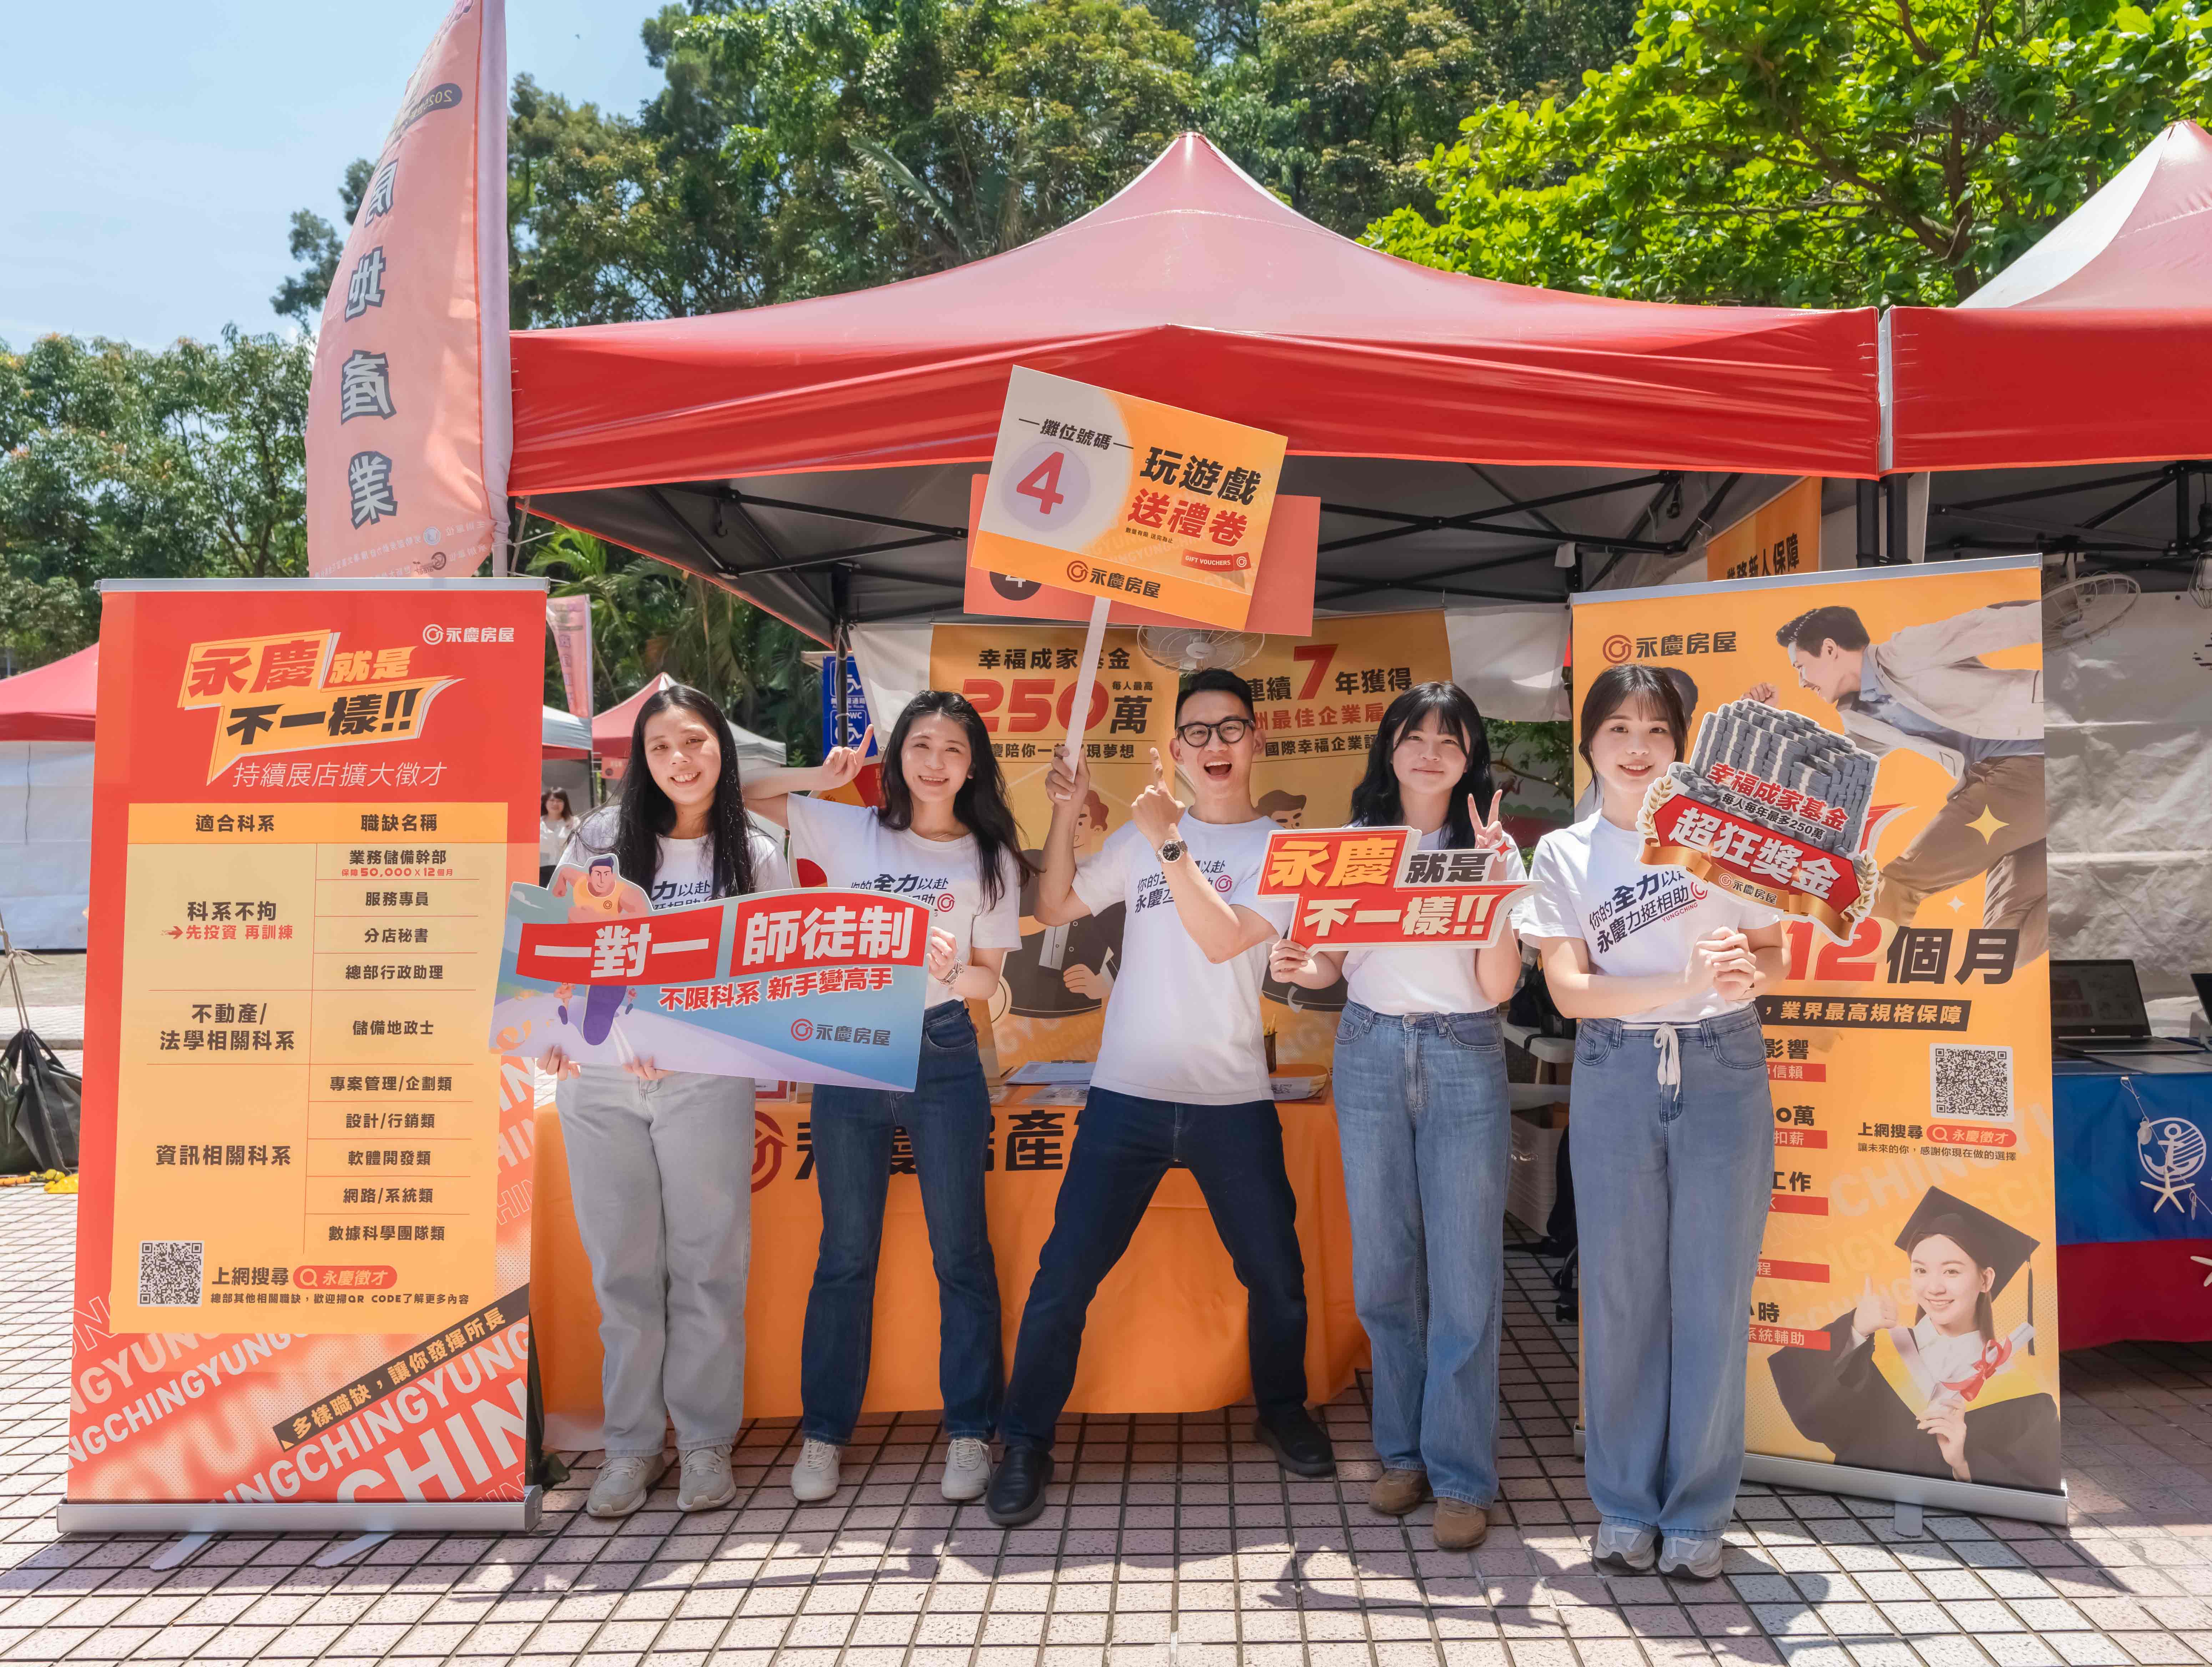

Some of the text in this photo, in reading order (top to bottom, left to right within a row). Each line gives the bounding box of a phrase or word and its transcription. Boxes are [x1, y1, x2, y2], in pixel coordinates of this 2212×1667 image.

[1040, 419, 1112, 450] 攤位號碼
[1016, 451, 1065, 515] 4
[1140, 446, 1262, 505] 玩遊戲
[1128, 488, 1247, 547] 送禮卷
[1125, 527, 1174, 544] 數量有限 送完為止
[1185, 555, 1198, 563] GIFT
[1090, 568, 1161, 598] 永慶房屋
[446, 627, 514, 642] 永慶房屋
[1636, 631, 1737, 658] 永慶房屋
[189, 639, 418, 698] 永慶 就是
[1112, 681, 1153, 691] 每人最高
[226, 688, 425, 745] 不一樣!!
[991, 743, 1135, 759] 慶陪你一現夢想
[233, 762, 446, 787] 持續展店擴大徵才
[1707, 763, 1848, 831] 幸福成家基金
[196, 815, 275, 832] 適合科系
[361, 814, 438, 831] 職缺名稱
[1722, 792, 1825, 840] 每人每年最多250萬
[349, 850, 446, 865] 業務儲備幹部
[1268, 838, 1492, 887] 永慶 就是
[1668, 805, 1840, 899] 超狂獎金
[365, 892, 429, 907] 服務專員
[1732, 880, 1778, 905] 永慶房屋
[187, 901, 277, 921] 科系不拘
[1303, 895, 1492, 937] 不一樣!!
[1597, 885, 1689, 953] 永慶力挺相助
[1662, 903, 1698, 922] YUNGCHING
[186, 924, 293, 940] 先投資 再訓練
[365, 929, 428, 943] 分店秘書
[534, 906, 915, 978] 一對一 師徒制
[345, 965, 443, 980] 總部行政助理
[659, 967, 893, 1012] 不限科系 新手變高手
[192, 1002, 268, 1024] 不動產/
[353, 1020, 434, 1036] 儲備地政士
[815, 1025, 891, 1046] 永慶房屋
[160, 1031, 294, 1052] 法學相關科系
[1764, 1039, 1809, 1060] 影響
[330, 1075, 452, 1092] 專案管理/企劃類
[345, 1113, 435, 1130] 設計/行銷類
[1774, 1131, 1804, 1146] 扣薪
[1857, 1123, 2009, 1144] 上網搜尋 永慶徵才
[156, 1145, 291, 1166] 資訊相關科系
[348, 1150, 431, 1166] 軟體開發類
[1857, 1142, 2017, 1161] 讓未來的你，感謝你現在做的選擇
[1773, 1171, 1812, 1192] 工作
[343, 1188, 433, 1204] 網路/系統類
[328, 1225, 445, 1242] 數據科學團隊類
[212, 1267, 388, 1286] 上網搜尋 永慶徵才
[1757, 1262, 1771, 1276] 程
[1749, 1327, 1805, 1346] 系統輔助
[292, 1307, 506, 1439] 多樣職缺，讓你發揮所長
